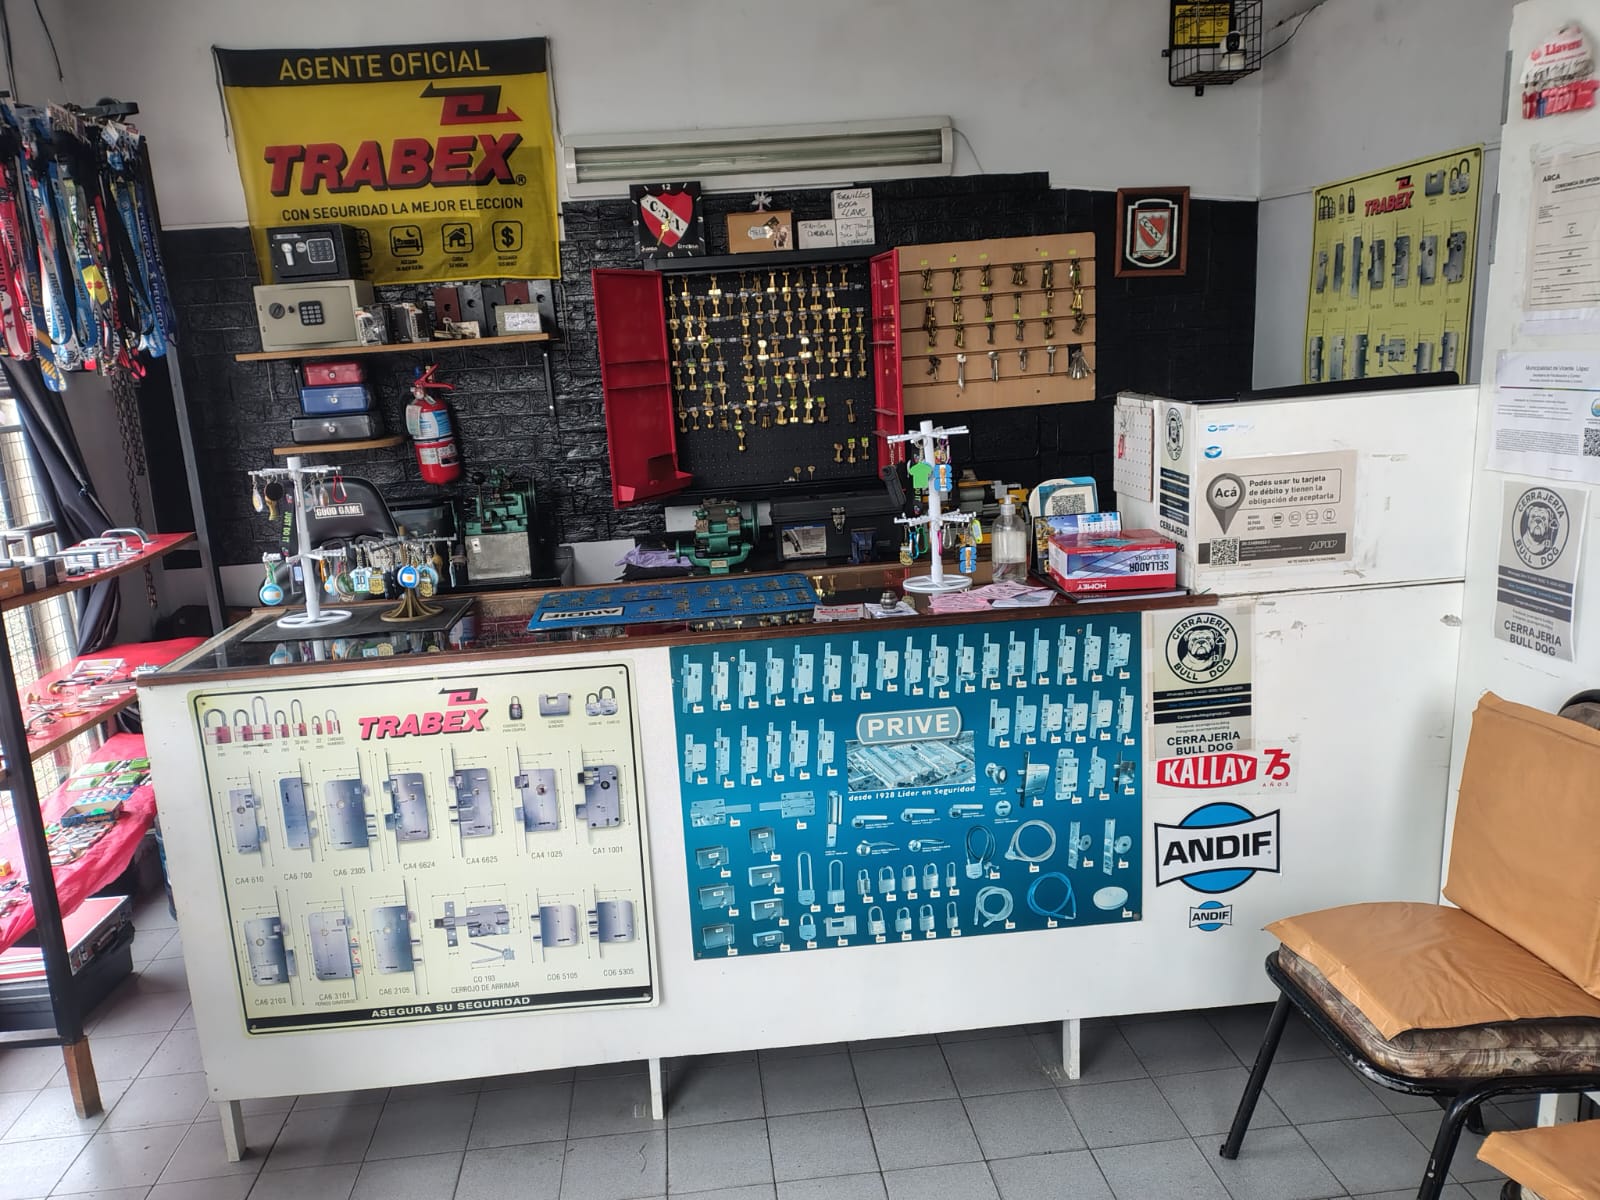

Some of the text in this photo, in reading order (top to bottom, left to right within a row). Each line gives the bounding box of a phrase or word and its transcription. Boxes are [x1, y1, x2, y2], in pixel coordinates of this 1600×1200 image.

[279, 49, 490, 81] AGENTE OFICIAL
[264, 133, 524, 197] TRABEX
[1542, 173, 1561, 183] ARCA
[661, 183, 671, 191] 12
[282, 196, 523, 222] CON SEGURIDAD LA MEJOR ELECCION
[1364, 190, 1414, 217] TRABEX
[138, 211, 153, 266] PEUGEOT
[151, 283, 166, 334] PEUGEOT
[1249, 479, 1272, 487] Podés
[1274, 478, 1291, 486] usar
[1301, 475, 1326, 485] tarjeta
[1214, 487, 1237, 498] Acá
[1260, 486, 1283, 496] débito
[1291, 485, 1314, 493] tienen
[1248, 492, 1334, 505] obligación de aceptarla
[1517, 491, 1565, 519] CERRAJERIA
[316, 505, 361, 516] GOOD GAME
[283, 511, 293, 526] JUST
[1515, 538, 1560, 566] BULL DOG
[1129, 561, 1169, 573] SELLADOR
[1172, 616, 1230, 641] CERRAJERIA
[1504, 620, 1562, 647] CERRAJERIA
[1509, 633, 1556, 657] BULL DOG
[1174, 658, 1231, 681] BULL DOG
[358, 708, 488, 741] TRABEX
[867, 713, 950, 738] PRIVE
[1166, 731, 1240, 746] CERRAJERIA
[1176, 742, 1233, 756] BULL DOG
[1164, 749, 1291, 785] KALLAY 75
[875, 791, 895, 799] 1928
[934, 785, 976, 795] Seguridad
[531, 850, 563, 860] CA4 1025
[592, 846, 624, 855] CA1 1001
[1163, 831, 1272, 866] ANDIF
[403, 862, 417, 870] CA4
[466, 857, 480, 865] CA4
[235, 876, 250, 885] CA4
[300, 872, 313, 880] 700
[1192, 911, 1230, 922] ANDIF
[451, 981, 520, 994] CERROJO DE ARRIMAR
[371, 997, 531, 1018] ASEGURA SU SEGURIDAD
